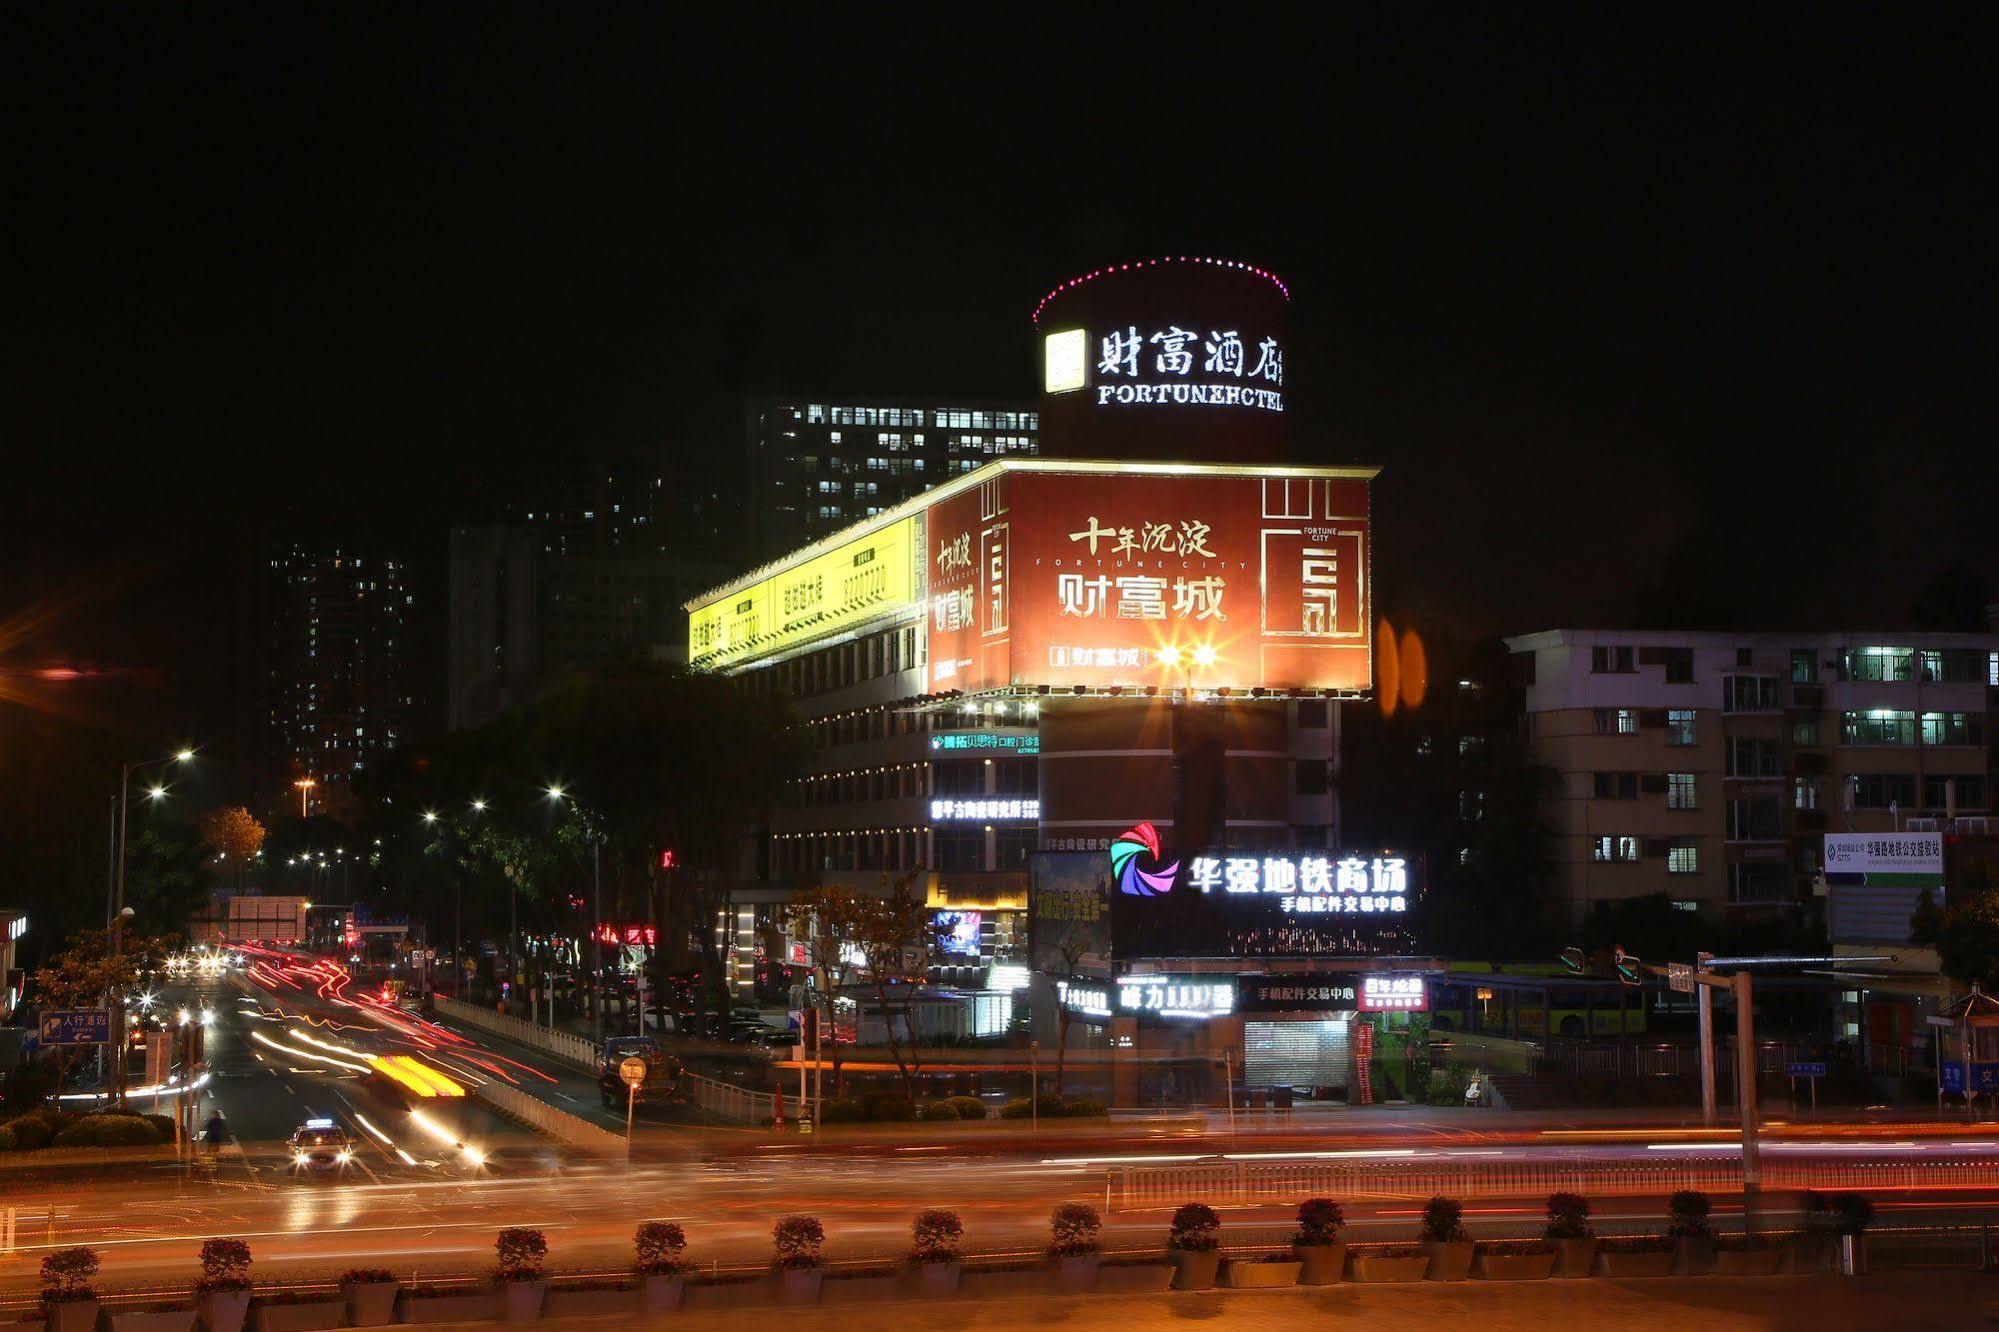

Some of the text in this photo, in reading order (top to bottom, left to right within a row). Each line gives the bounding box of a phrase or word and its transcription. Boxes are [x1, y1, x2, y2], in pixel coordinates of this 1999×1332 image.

[1068, 516, 1217, 562] 十年沉淀
[1304, 527, 1337, 535] FORTUNE
[1035, 558, 1247, 571] FORTUNE CITY
[1058, 574, 1227, 622] 财富城
[1867, 840, 1940, 857] 华强路地铁公交接驳站
[1189, 857, 1406, 893] 华强地铁商场
[1280, 896, 1406, 913] 手机配件交易中心
[1258, 987, 1355, 1001] 手机配件交易中心
